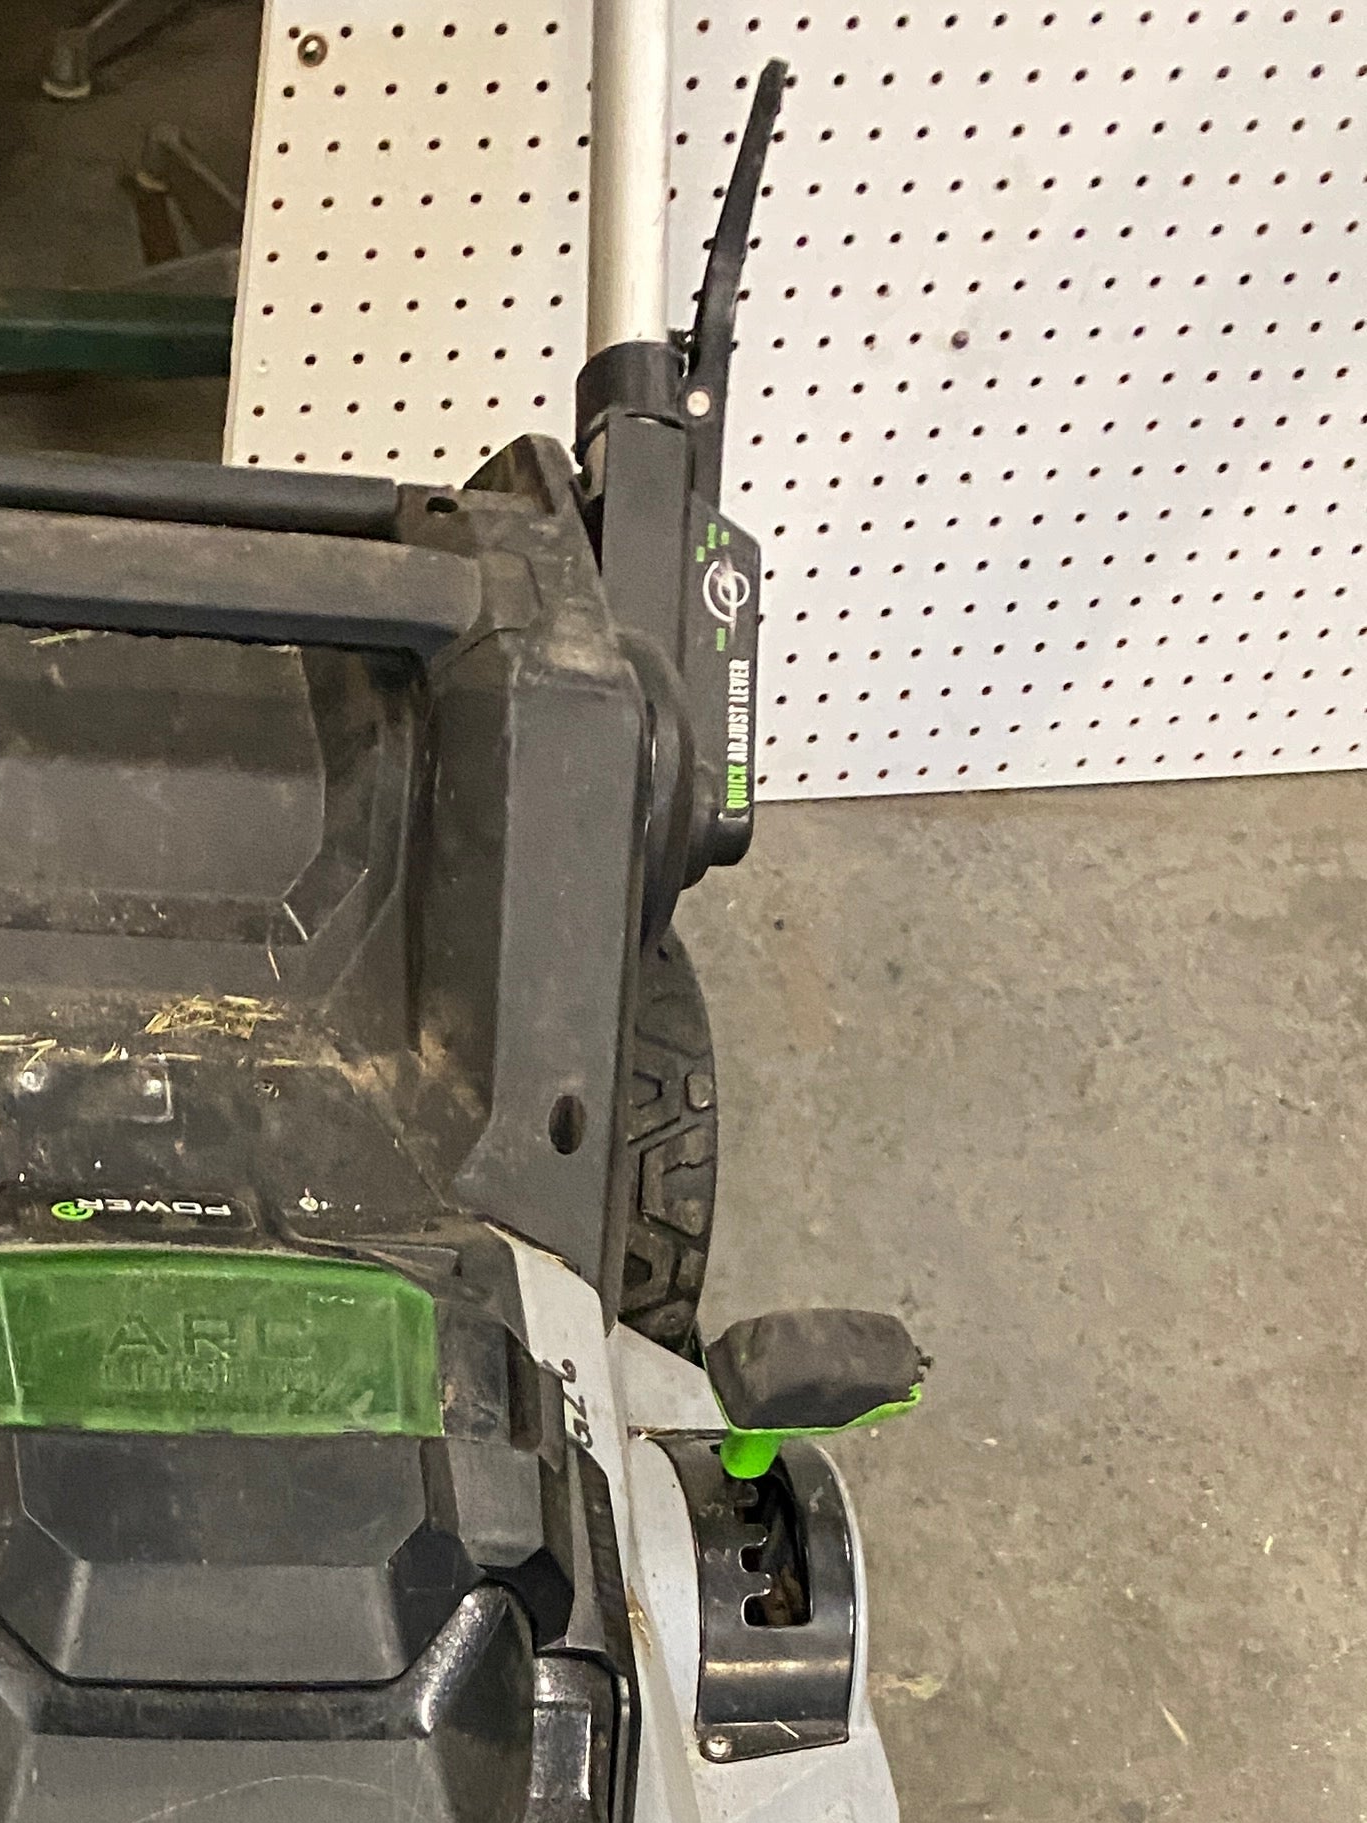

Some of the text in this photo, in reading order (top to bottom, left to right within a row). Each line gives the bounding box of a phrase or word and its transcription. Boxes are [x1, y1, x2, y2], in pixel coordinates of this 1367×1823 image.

[725, 659, 750, 808] QUICK ADJUST LEVER
